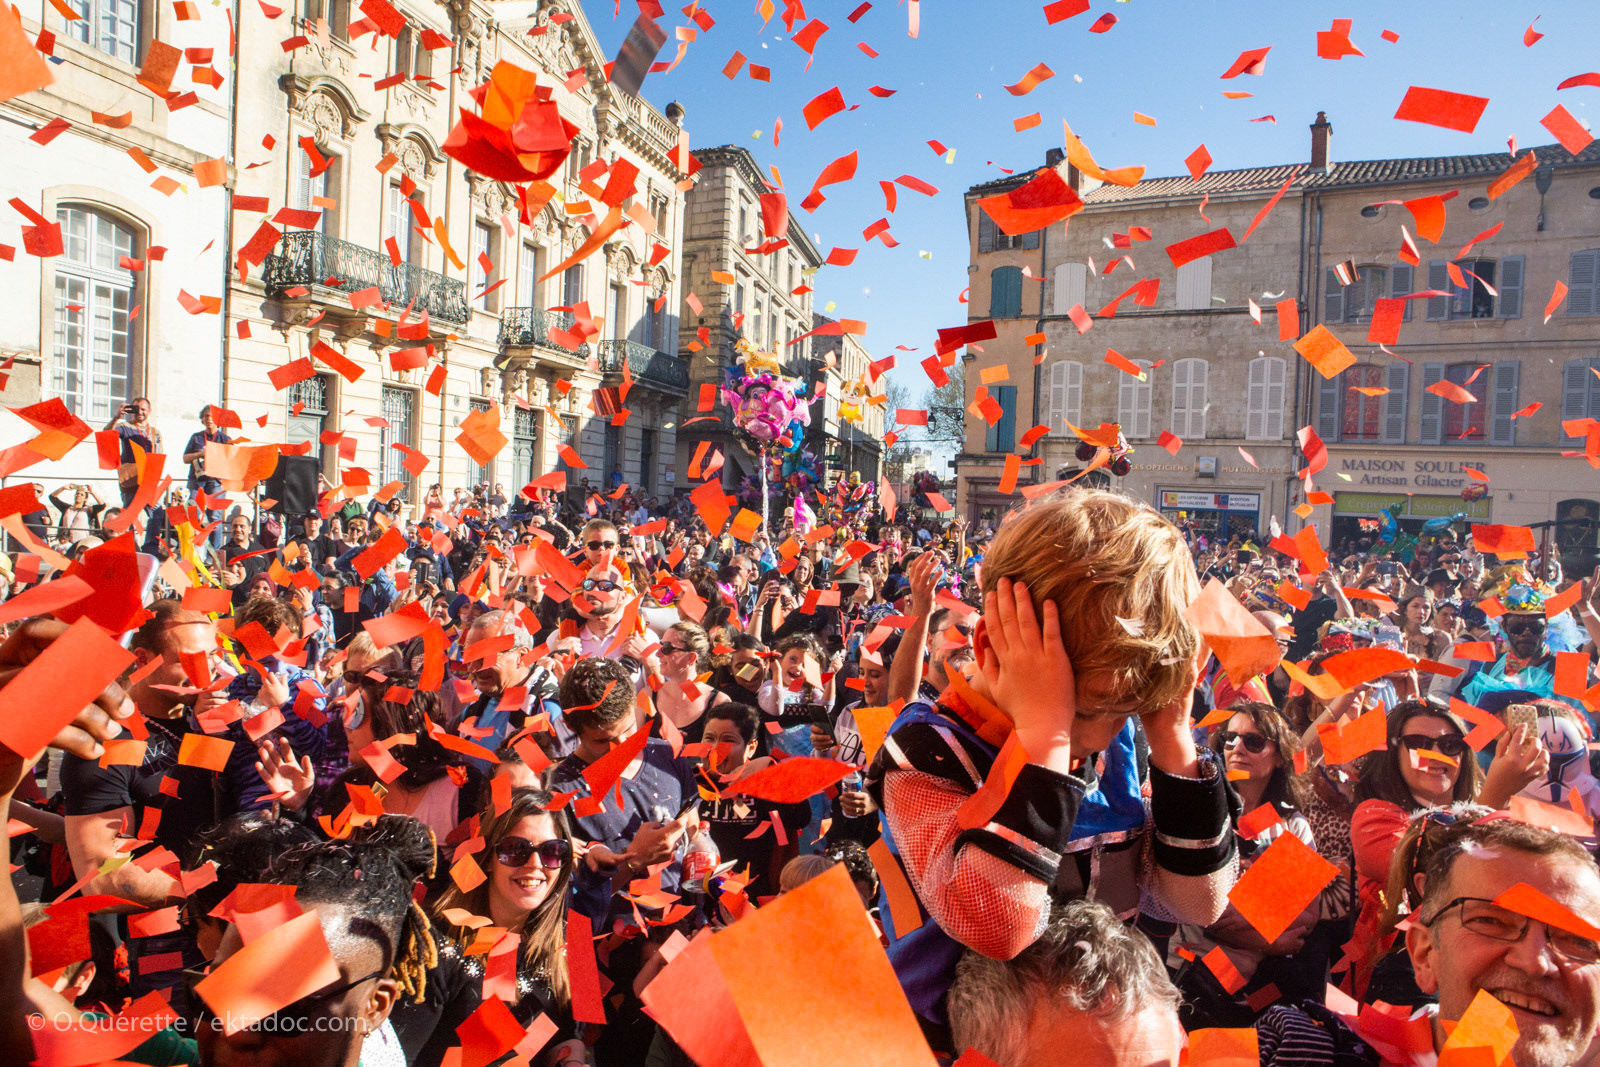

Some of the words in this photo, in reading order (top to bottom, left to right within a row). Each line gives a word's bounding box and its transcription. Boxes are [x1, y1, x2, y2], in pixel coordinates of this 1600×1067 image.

[1221, 466, 1281, 474] MUTUALISTES
[1343, 459, 1405, 472] MAISON
[1414, 461, 1487, 474] SOULIER
[1360, 474, 1407, 485] Artisan
[1414, 475, 1465, 487] Glacier
[1415, 501, 1446, 512] Salon
[1449, 502, 1464, 513] de
[1465, 502, 1486, 514] Thé
